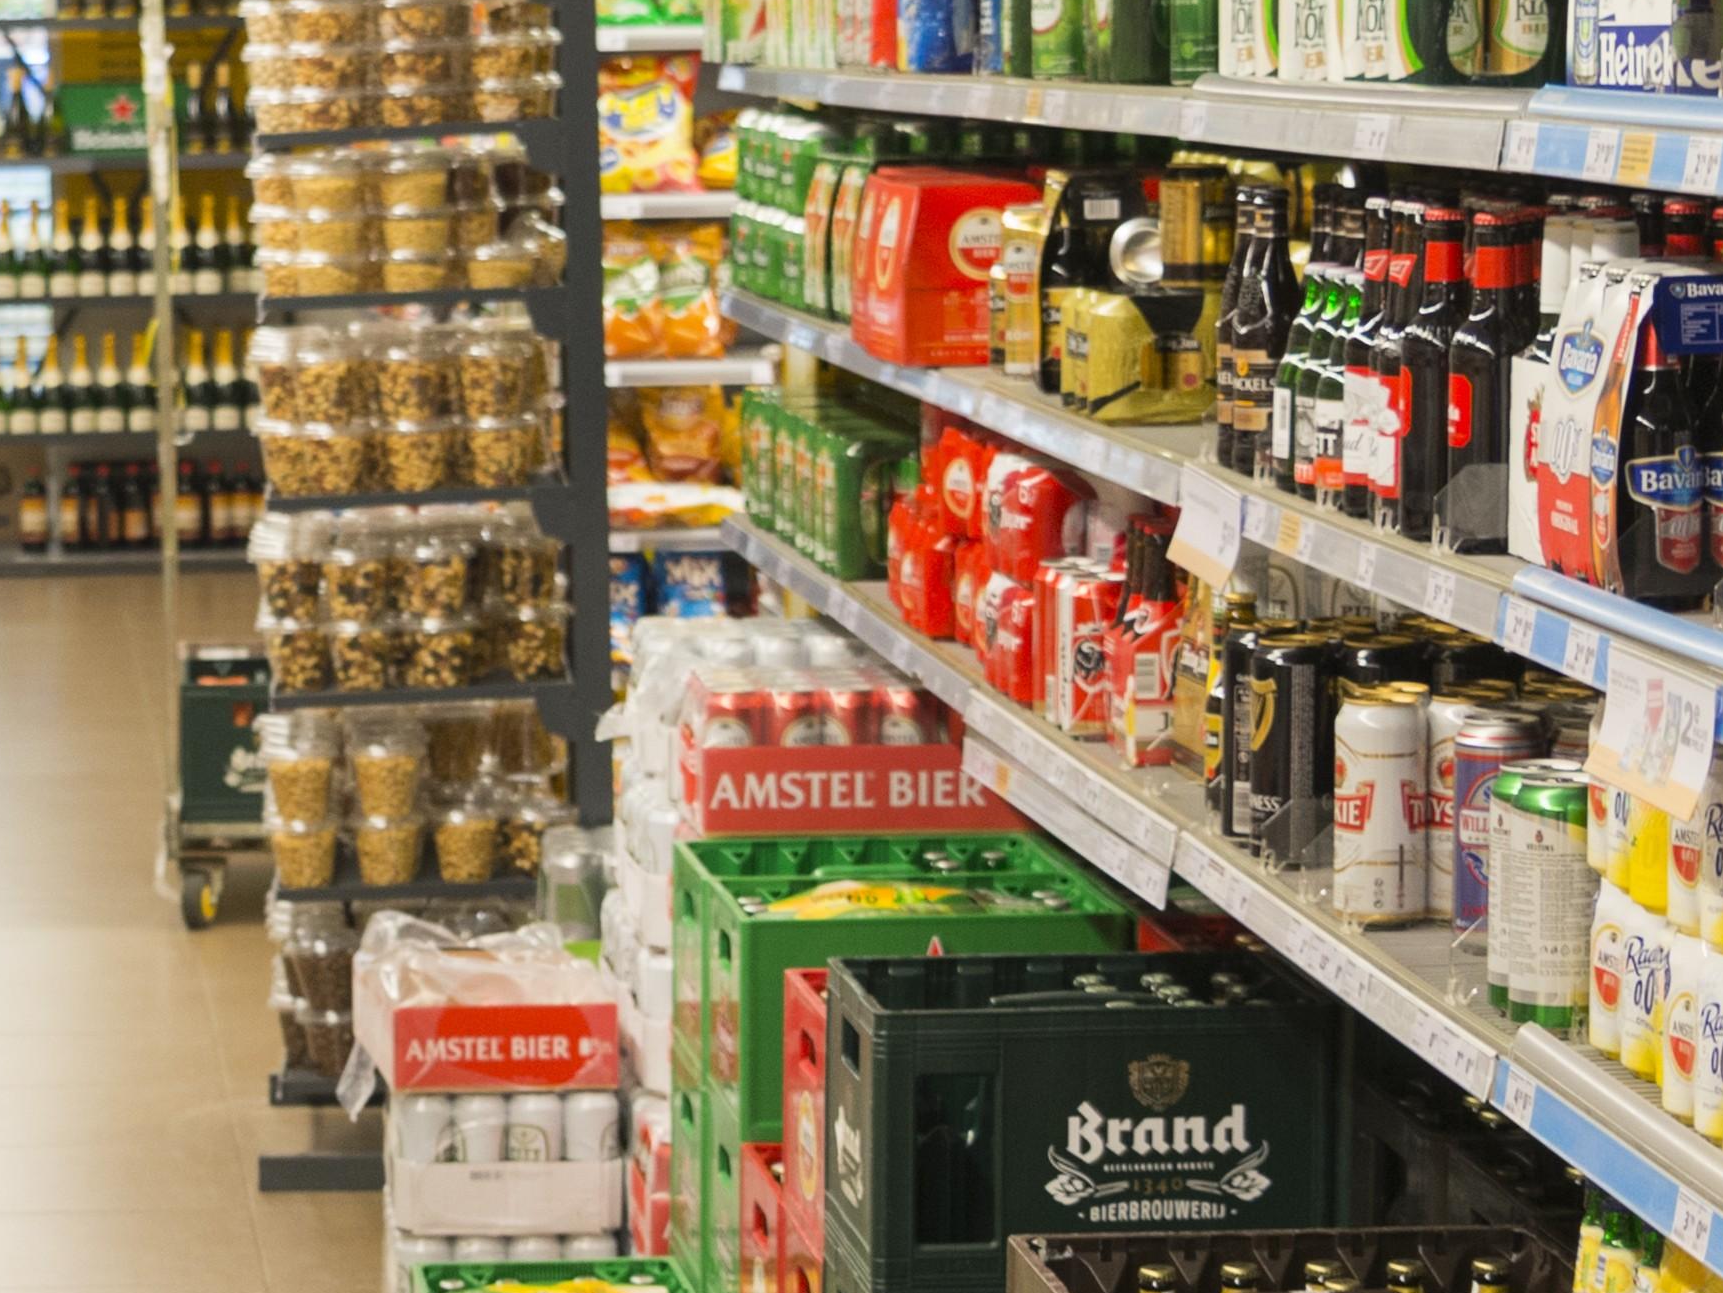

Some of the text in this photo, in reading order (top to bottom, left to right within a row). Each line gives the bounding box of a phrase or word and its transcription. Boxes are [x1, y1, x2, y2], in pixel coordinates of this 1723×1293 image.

[711, 770, 986, 811] AMSTEL BIER
[406, 1034, 572, 1062] AMSTEL BIER
[1065, 1103, 1251, 1166] Brand
[1132, 1178, 1184, 1192] 1340
[1089, 1200, 1228, 1222] BIERBROUWERIJ
